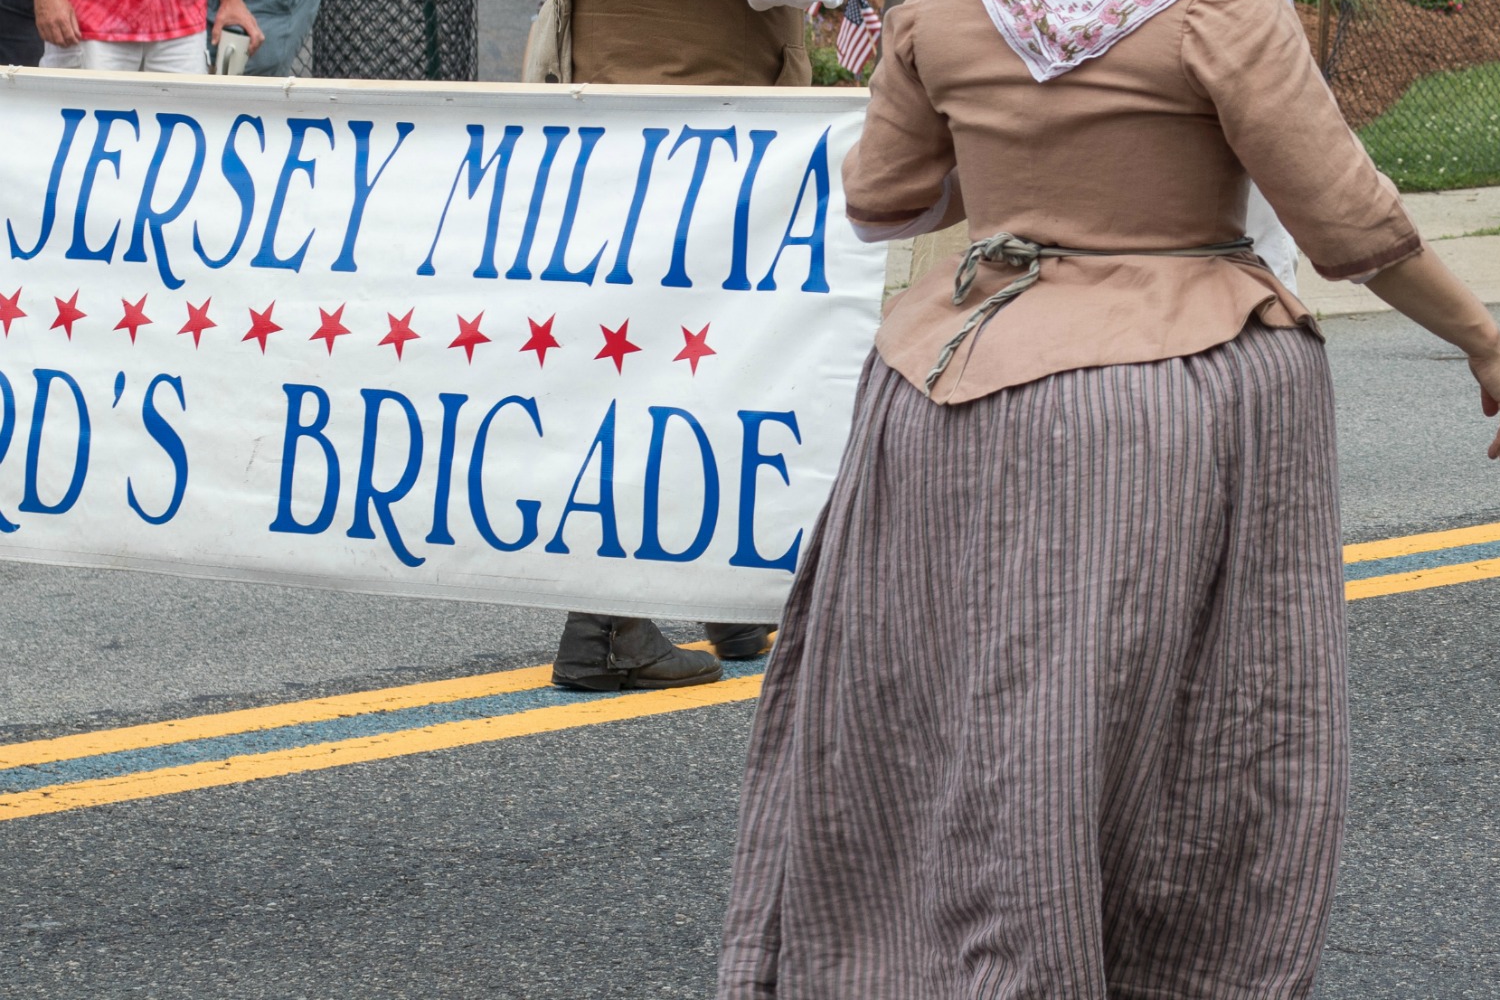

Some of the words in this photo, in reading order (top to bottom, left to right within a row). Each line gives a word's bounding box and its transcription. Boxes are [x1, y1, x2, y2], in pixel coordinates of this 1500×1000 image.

[7, 109, 414, 290] JERSEY
[417, 125, 830, 292] MILITIA
[0, 369, 188, 533] D'S
[270, 384, 802, 573] BRIGADE
